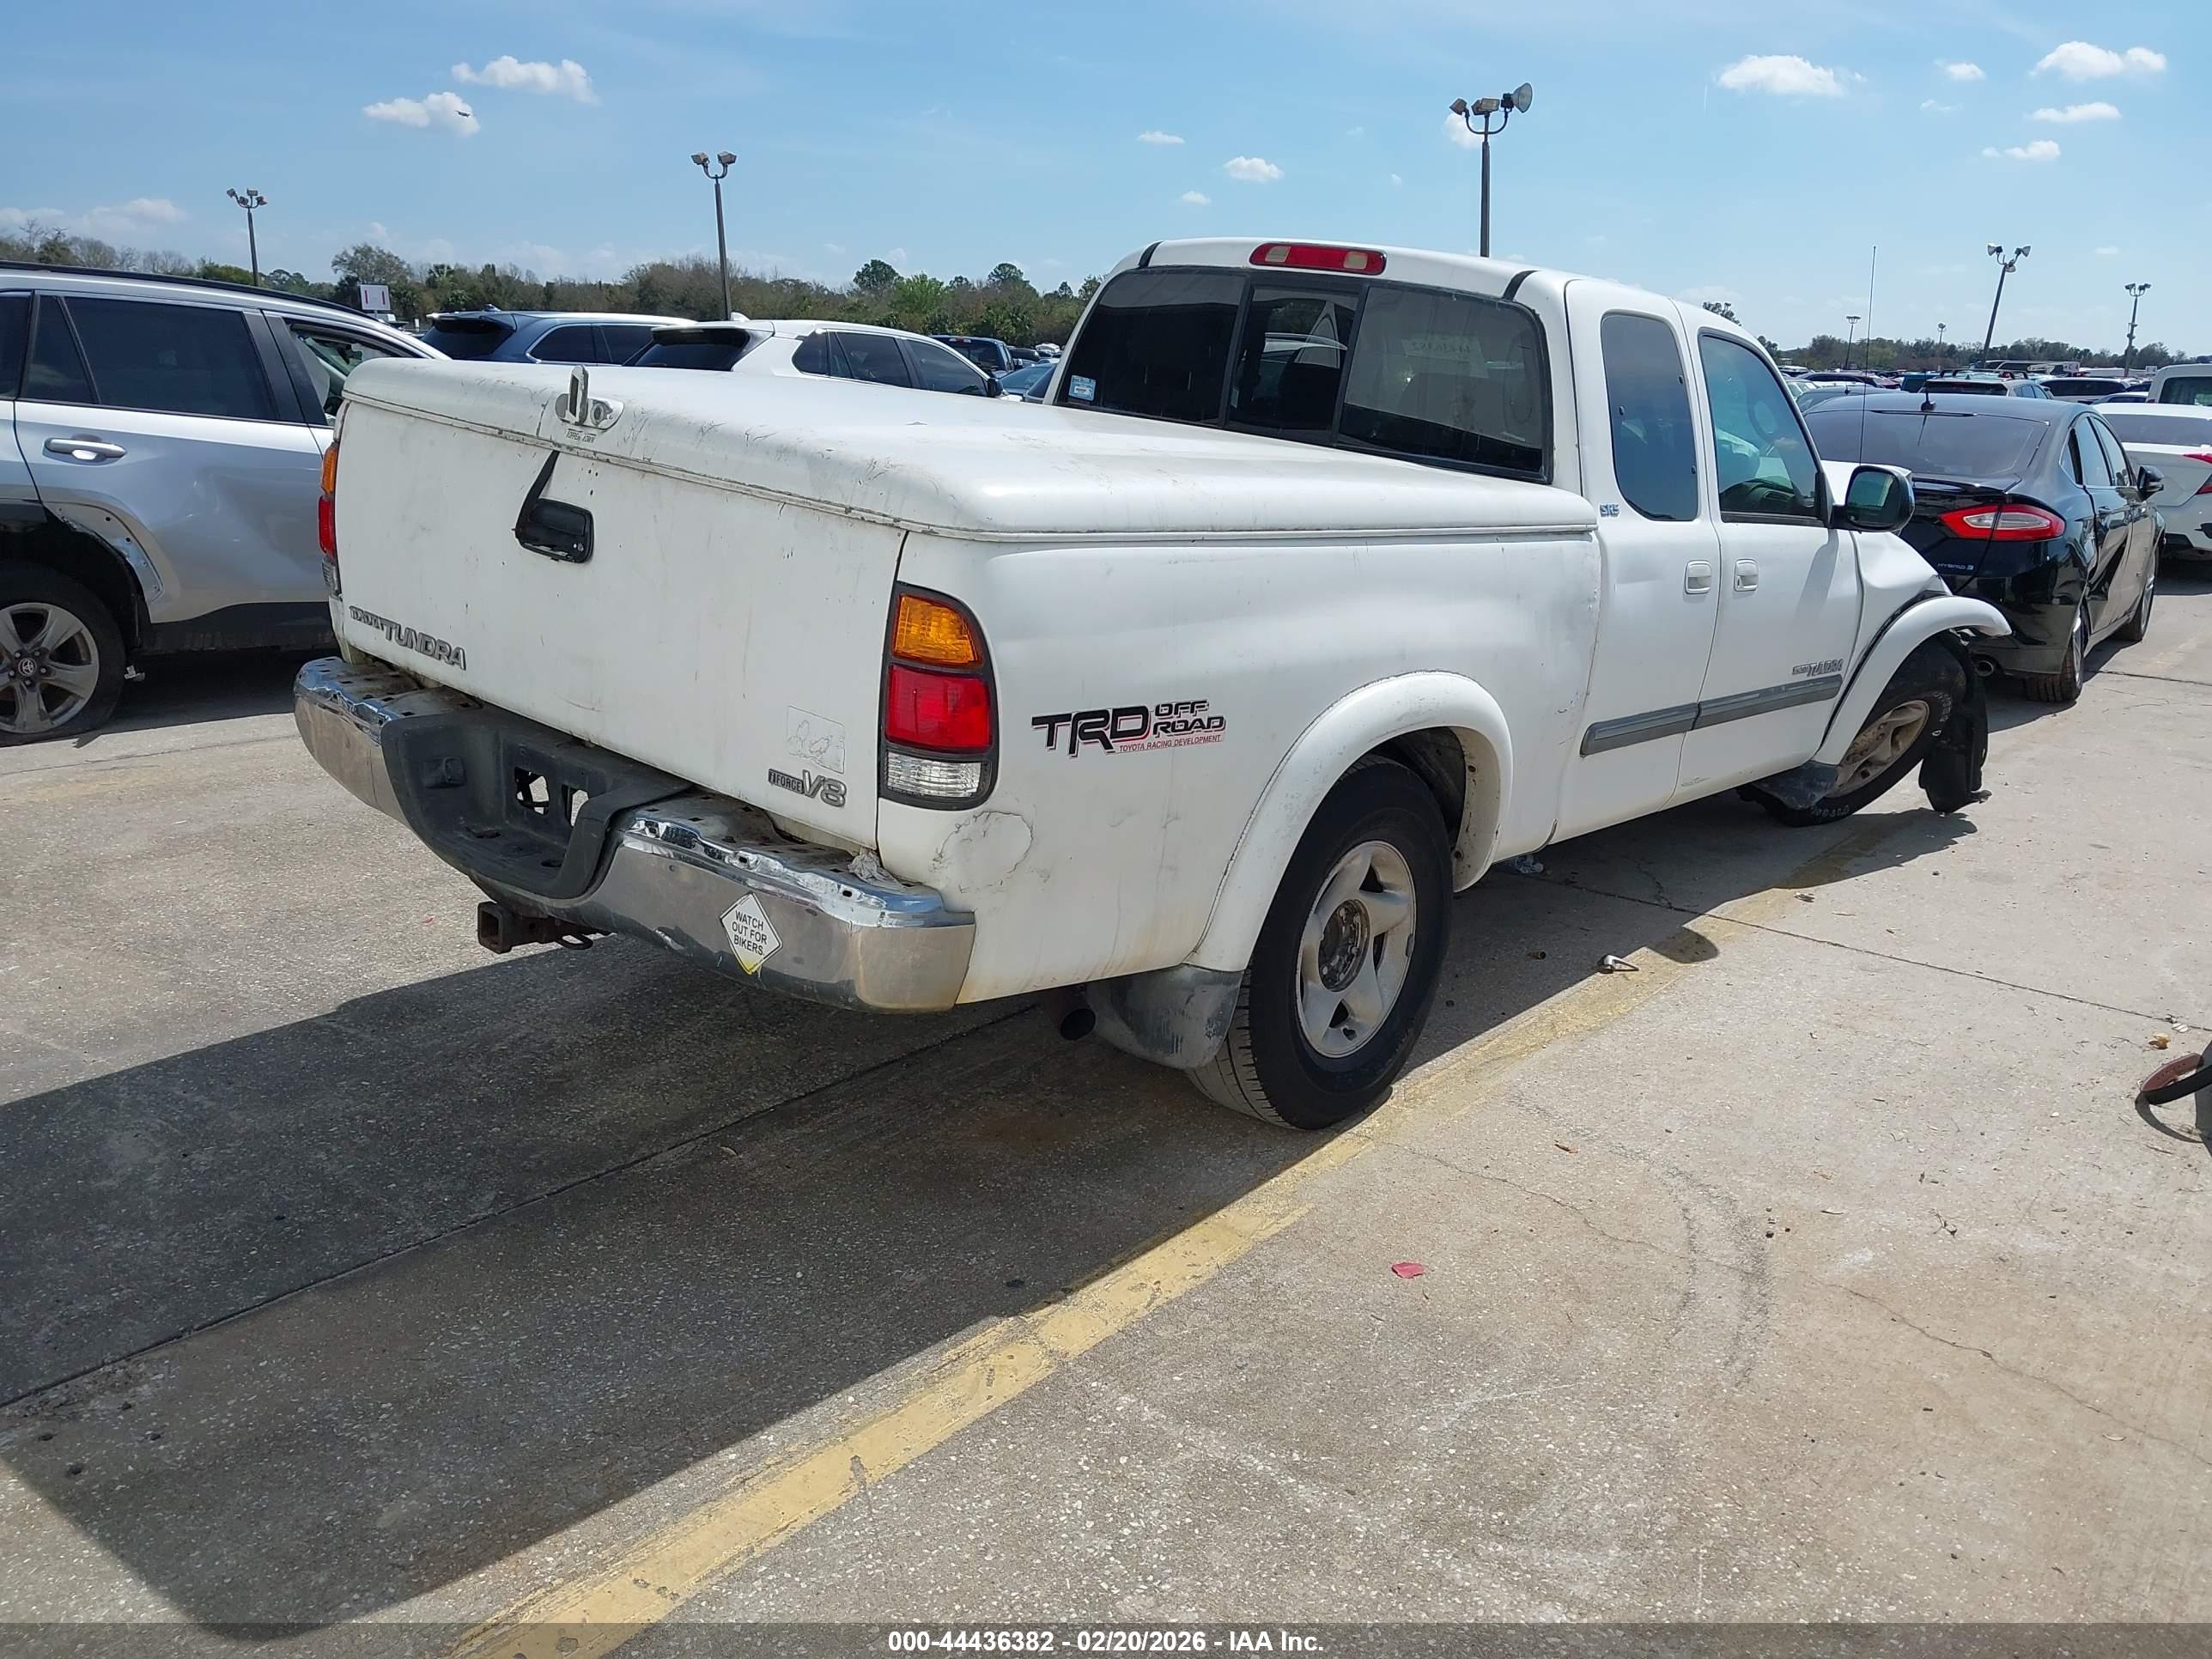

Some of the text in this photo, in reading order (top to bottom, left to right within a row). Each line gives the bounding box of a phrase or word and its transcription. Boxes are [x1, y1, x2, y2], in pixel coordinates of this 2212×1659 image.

[379, 617, 467, 671] TUNDRA
[1154, 700, 1210, 720] OFF
[1030, 705, 1152, 757] TRD
[1152, 715, 1226, 738] ROAD
[1119, 734, 1221, 752] TOYOTA RACING DEVELOPMENT
[802, 769, 848, 808] V8
[735, 910, 764, 932] WATCH
[732, 921, 768, 945] OUT FOR
